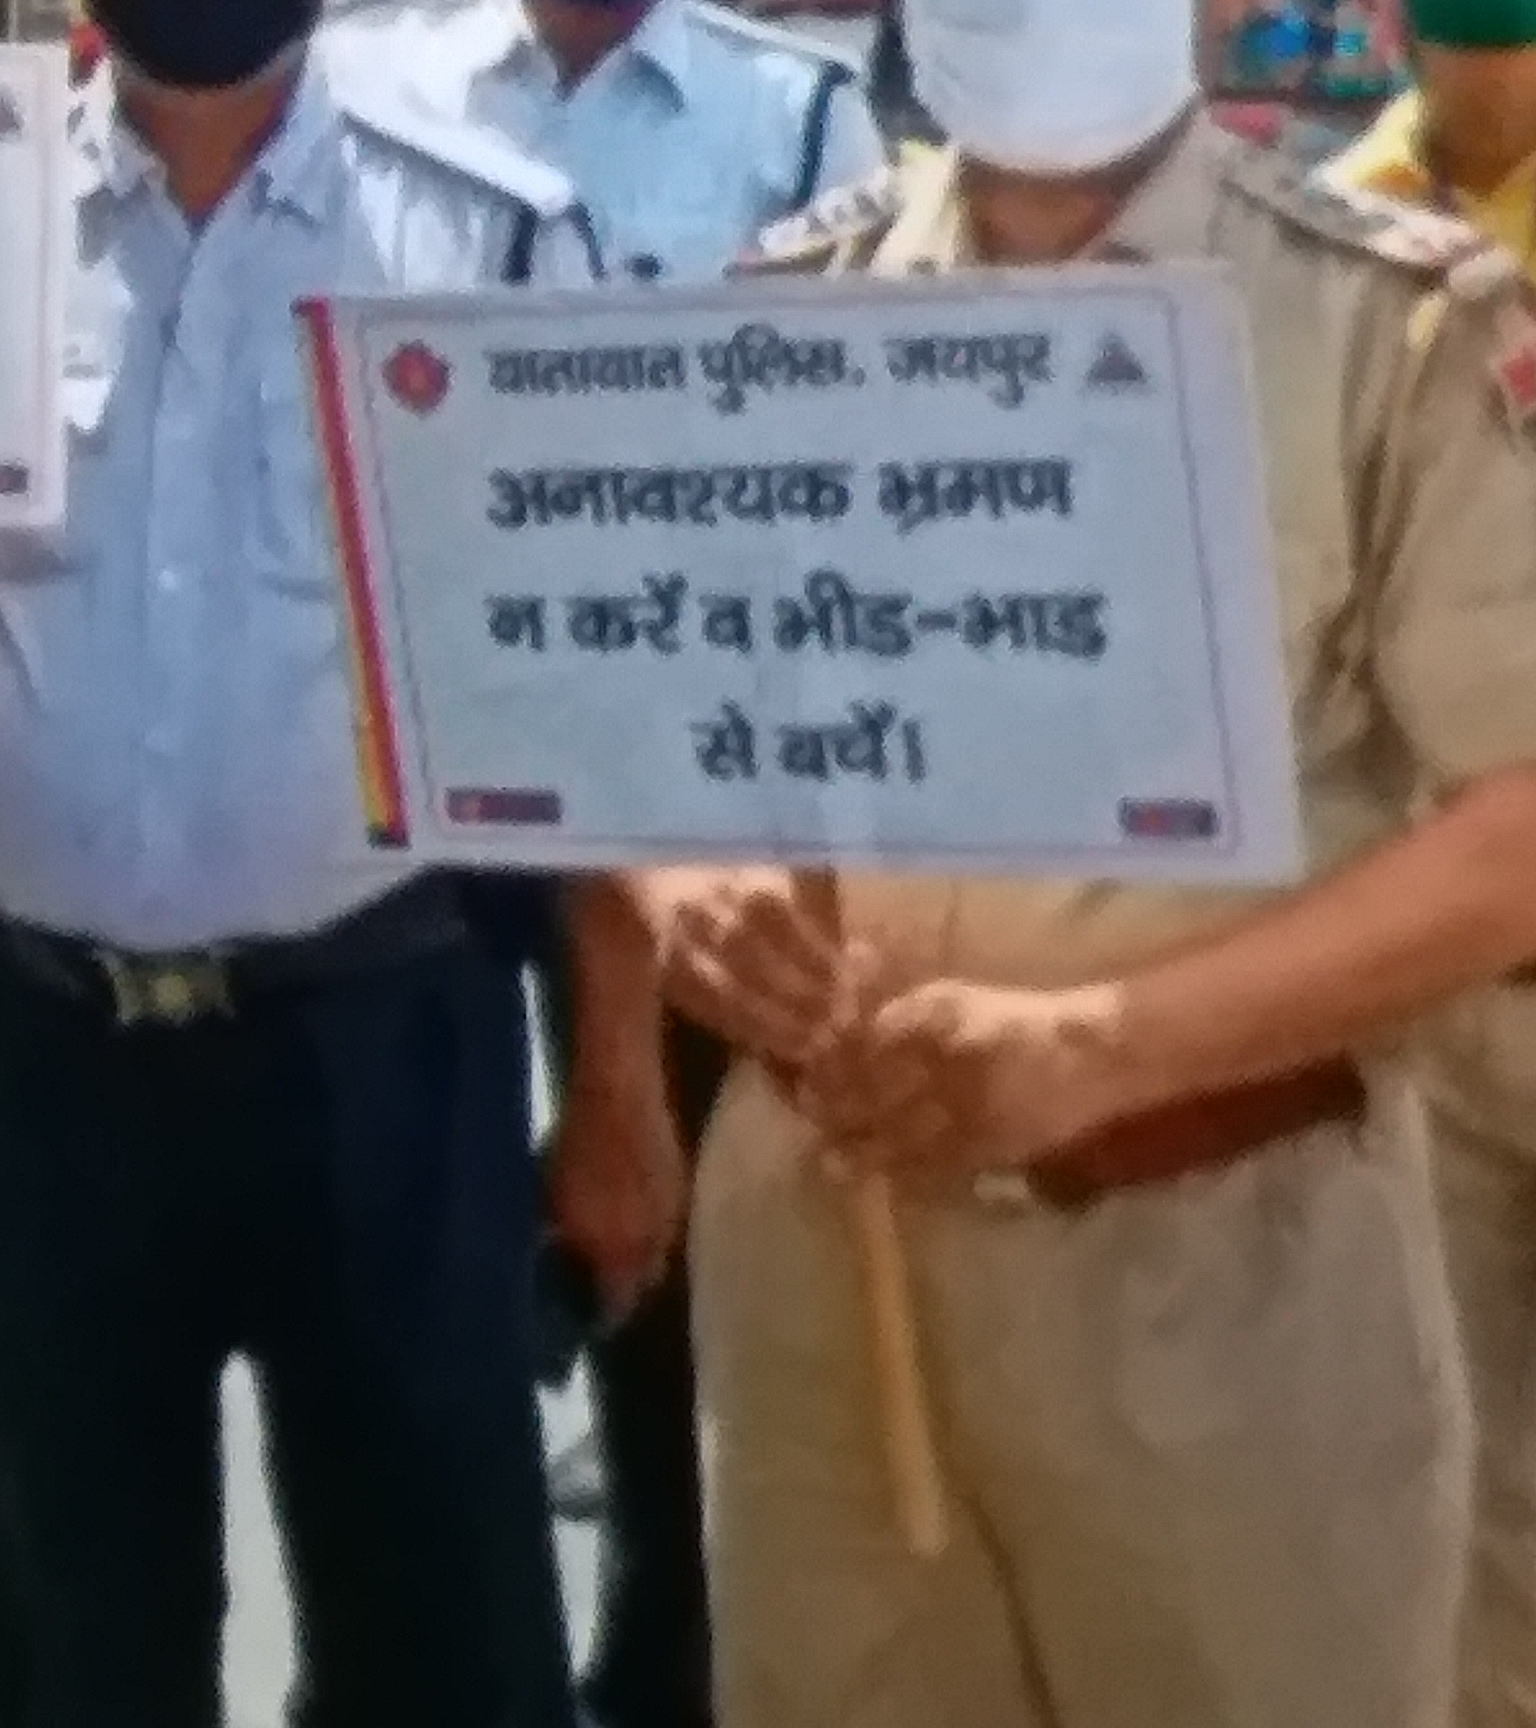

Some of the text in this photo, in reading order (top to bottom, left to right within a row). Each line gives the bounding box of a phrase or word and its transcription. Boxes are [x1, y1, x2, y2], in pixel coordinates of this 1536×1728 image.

[485, 342, 687, 396] यातायात
[881, 330, 1054, 410] जयपुर
[485, 456, 1077, 537] अनावश्यक भ्रमण
[484, 593, 548, 654] न
[563, 569, 688, 657] करें
[697, 593, 754, 656] व
[688, 696, 759, 783] से
